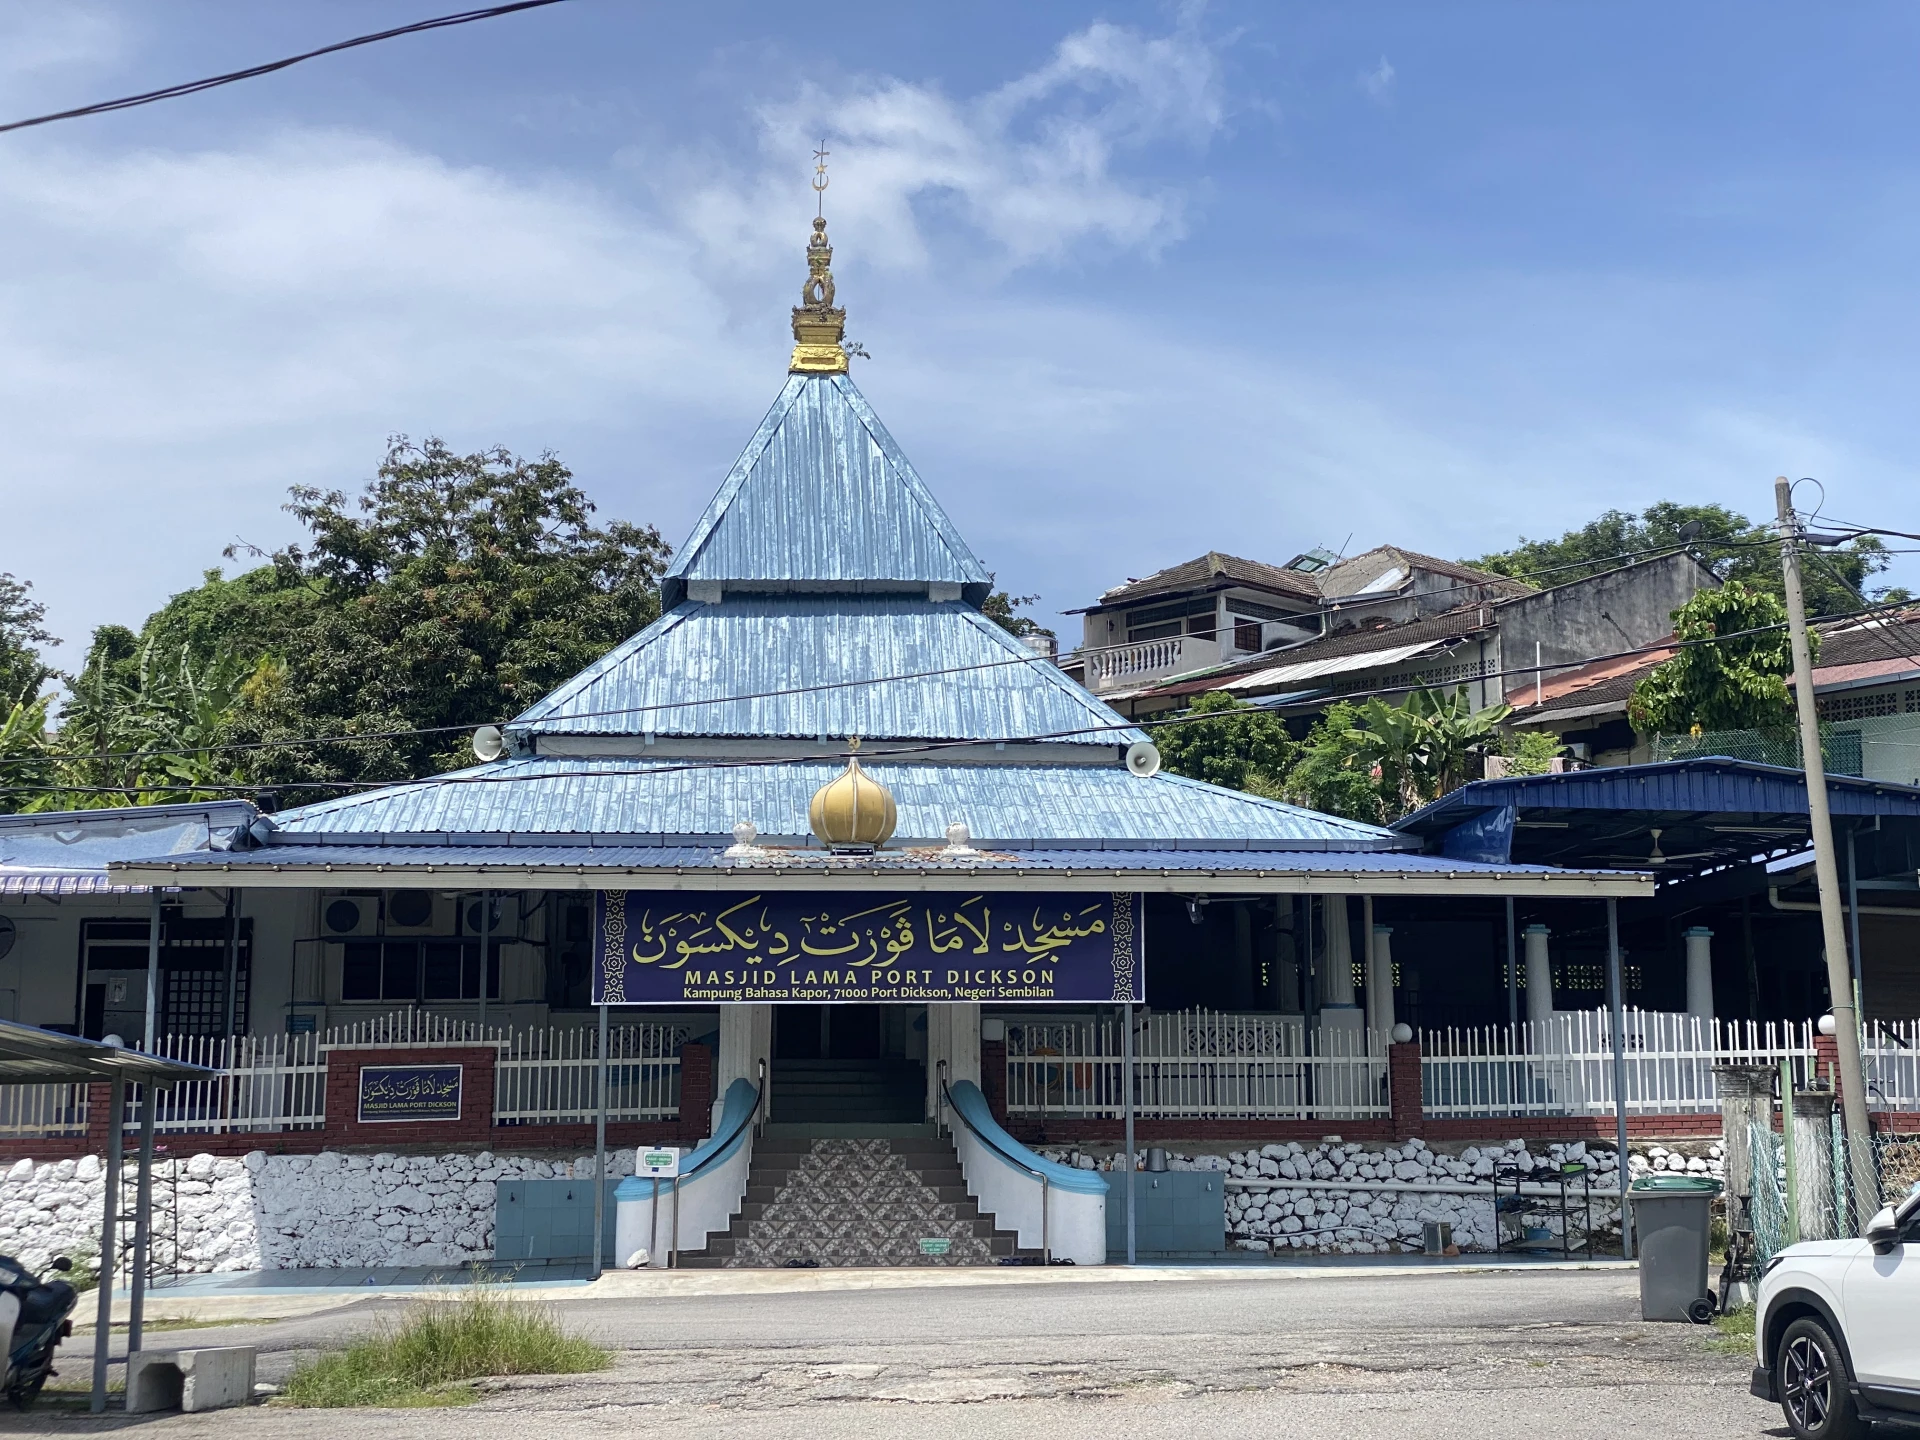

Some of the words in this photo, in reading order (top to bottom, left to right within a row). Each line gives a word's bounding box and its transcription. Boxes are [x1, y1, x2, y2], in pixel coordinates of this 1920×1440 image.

[684, 970, 776, 985] MASJID
[790, 970, 857, 985] LAMA
[871, 969, 933, 984] PORT
[947, 969, 1054, 984] DICKSON
[683, 987, 742, 1000] Kampung
[745, 987, 788, 998] Bahasa
[791, 987, 831, 1000] Kapor,
[834, 988, 868, 999] 71000
[871, 987, 898, 998] Port
[901, 986, 951, 999] Dickson,
[955, 986, 995, 1000] Negeri
[998, 986, 1054, 998] Sembilan
